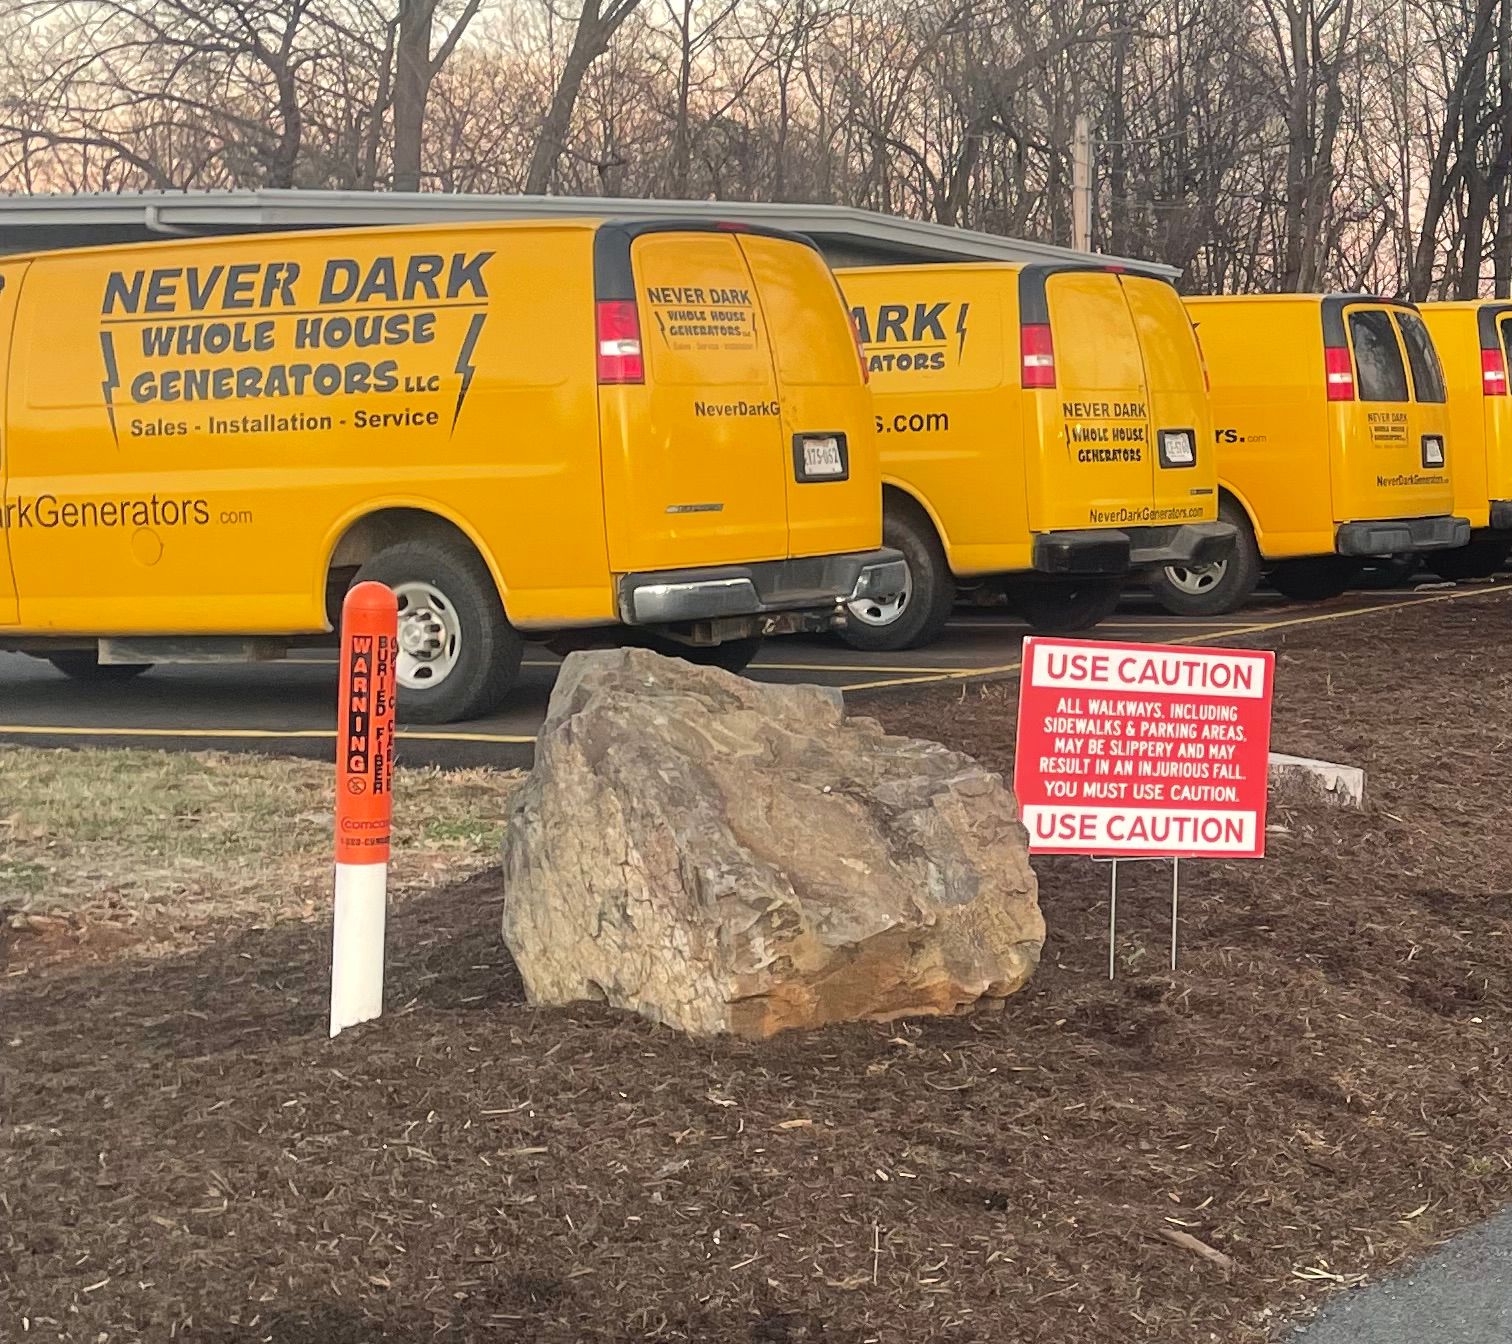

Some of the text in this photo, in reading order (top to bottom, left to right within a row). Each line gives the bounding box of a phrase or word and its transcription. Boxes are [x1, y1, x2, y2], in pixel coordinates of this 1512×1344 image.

[101, 250, 497, 314] NEVER DARK
[647, 287, 752, 305] NEVER DARK
[667, 311, 746, 322] WHOLE HOUSE
[141, 312, 437, 357] WHOLE HOUSE
[670, 325, 741, 336] GENERATORS
[130, 360, 440, 404] GENERATORS LLC
[694, 401, 780, 416] NeverDarkG
[1063, 403, 1146, 417] NEVER DARK
[130, 418, 188, 437] Sales
[208, 412, 332, 435] Installation
[353, 409, 439, 429] Service
[1072, 427, 1144, 442] WHOLE HOUSE
[1078, 449, 1141, 463] GENERATORS
[0, 494, 210, 528] rkGenerators
[376, 636, 388, 716] BURIED
[1047, 653, 1252, 690] USE CAUTION
[350, 637, 371, 771] WARNING
[1057, 697, 1083, 714] ALL
[1170, 703, 1238, 721] INCLUDING
[1043, 717, 1121, 736] SIDEWALKS
[1125, 722, 1136, 736] &
[1140, 721, 1198, 740] PARKING
[1054, 737, 1236, 760] MAY BE SLIPPERY AND MAY
[373, 727, 385, 795] FIBER
[1039, 757, 1246, 780] RESULT IN AN INJURIOUS FALL.
[1044, 780, 1240, 803] YOU MUST USE CAUTION.
[1036, 812, 1244, 843] USE CAUTION
